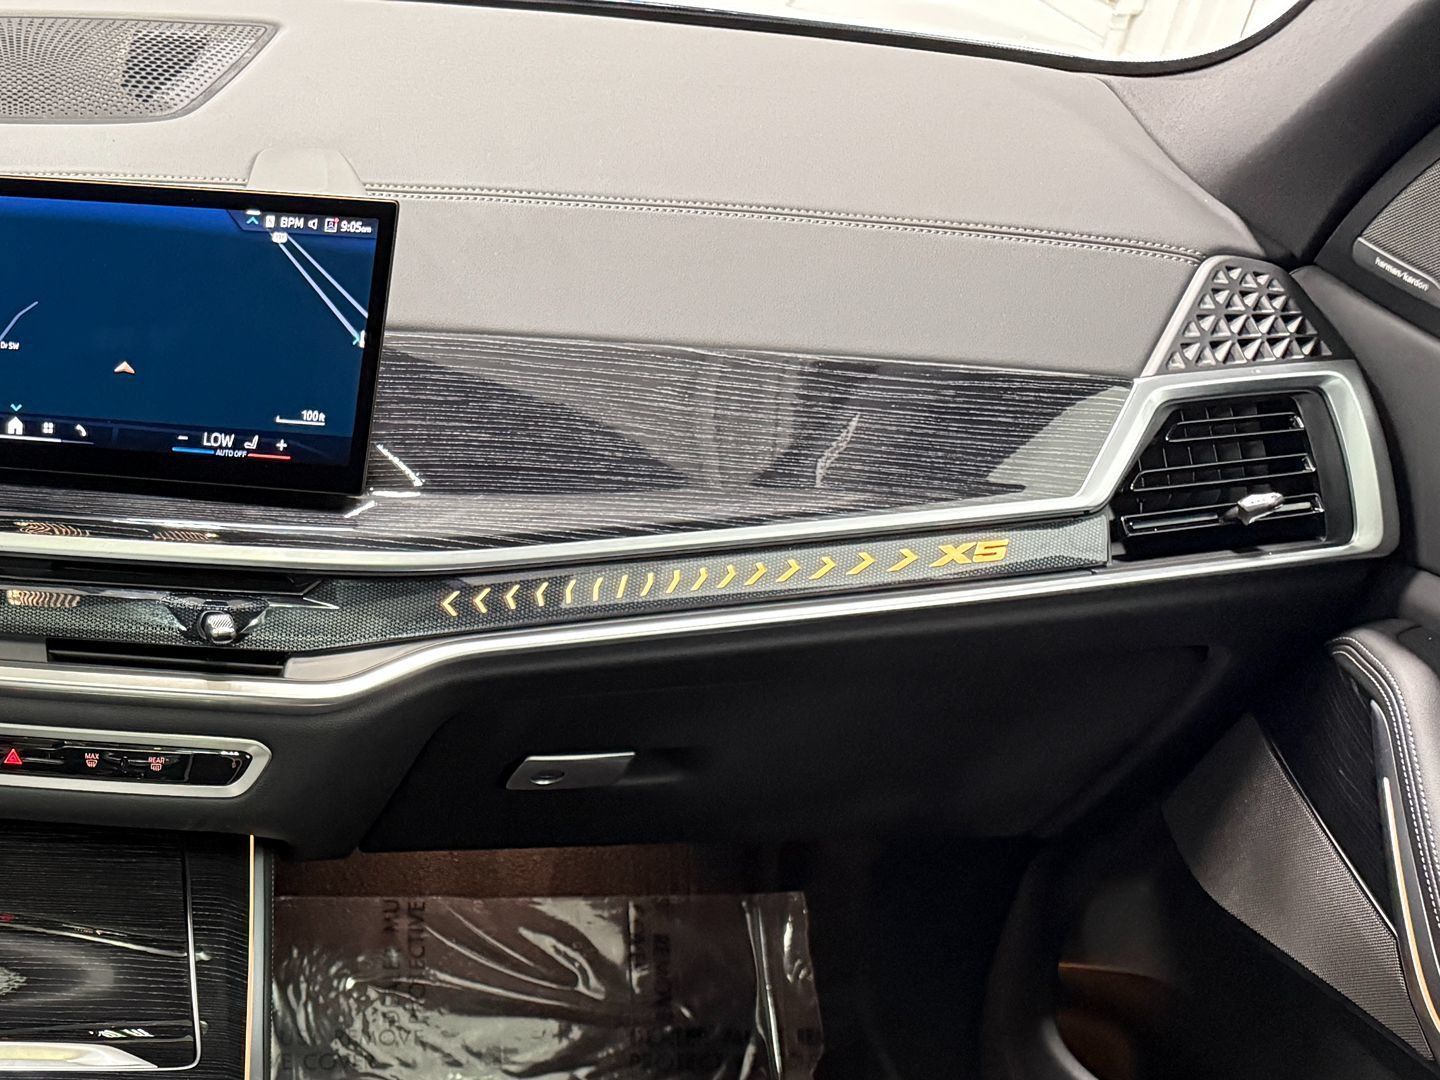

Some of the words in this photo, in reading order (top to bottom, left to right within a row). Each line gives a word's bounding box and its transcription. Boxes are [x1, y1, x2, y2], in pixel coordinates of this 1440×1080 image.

[280, 216, 304, 229] BPM
[1375, 256, 1429, 291] harman/kardon
[203, 432, 235, 447] LOW
[216, 449, 233, 457] AUTO
[234, 450, 247, 458] OFF
[928, 539, 1009, 567] X5
